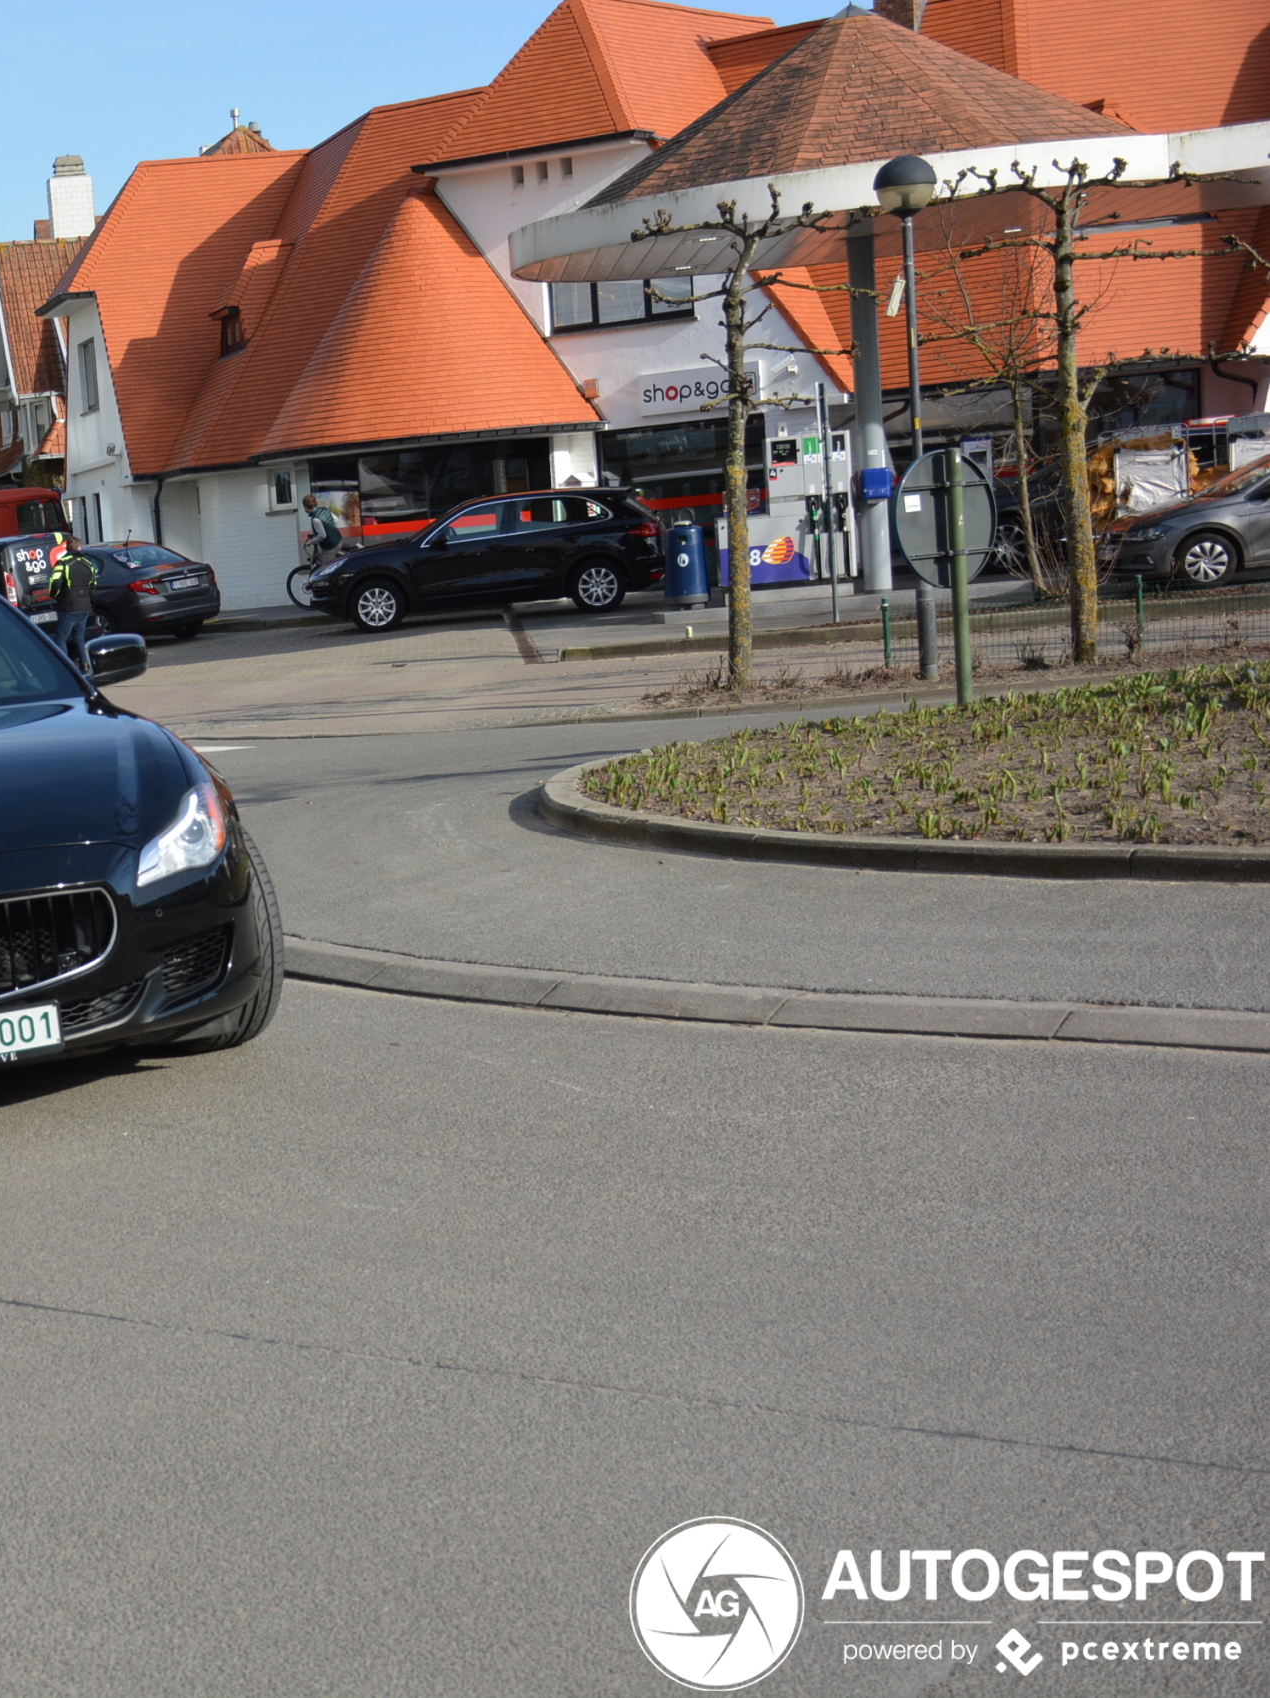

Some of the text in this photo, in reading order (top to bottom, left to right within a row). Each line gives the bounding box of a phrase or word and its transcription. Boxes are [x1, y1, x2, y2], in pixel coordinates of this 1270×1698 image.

[643, 379, 730, 403] shop&go
[16, 548, 44, 562] shop
[749, 549, 762, 567] 8
[25, 560, 47, 573] &go
